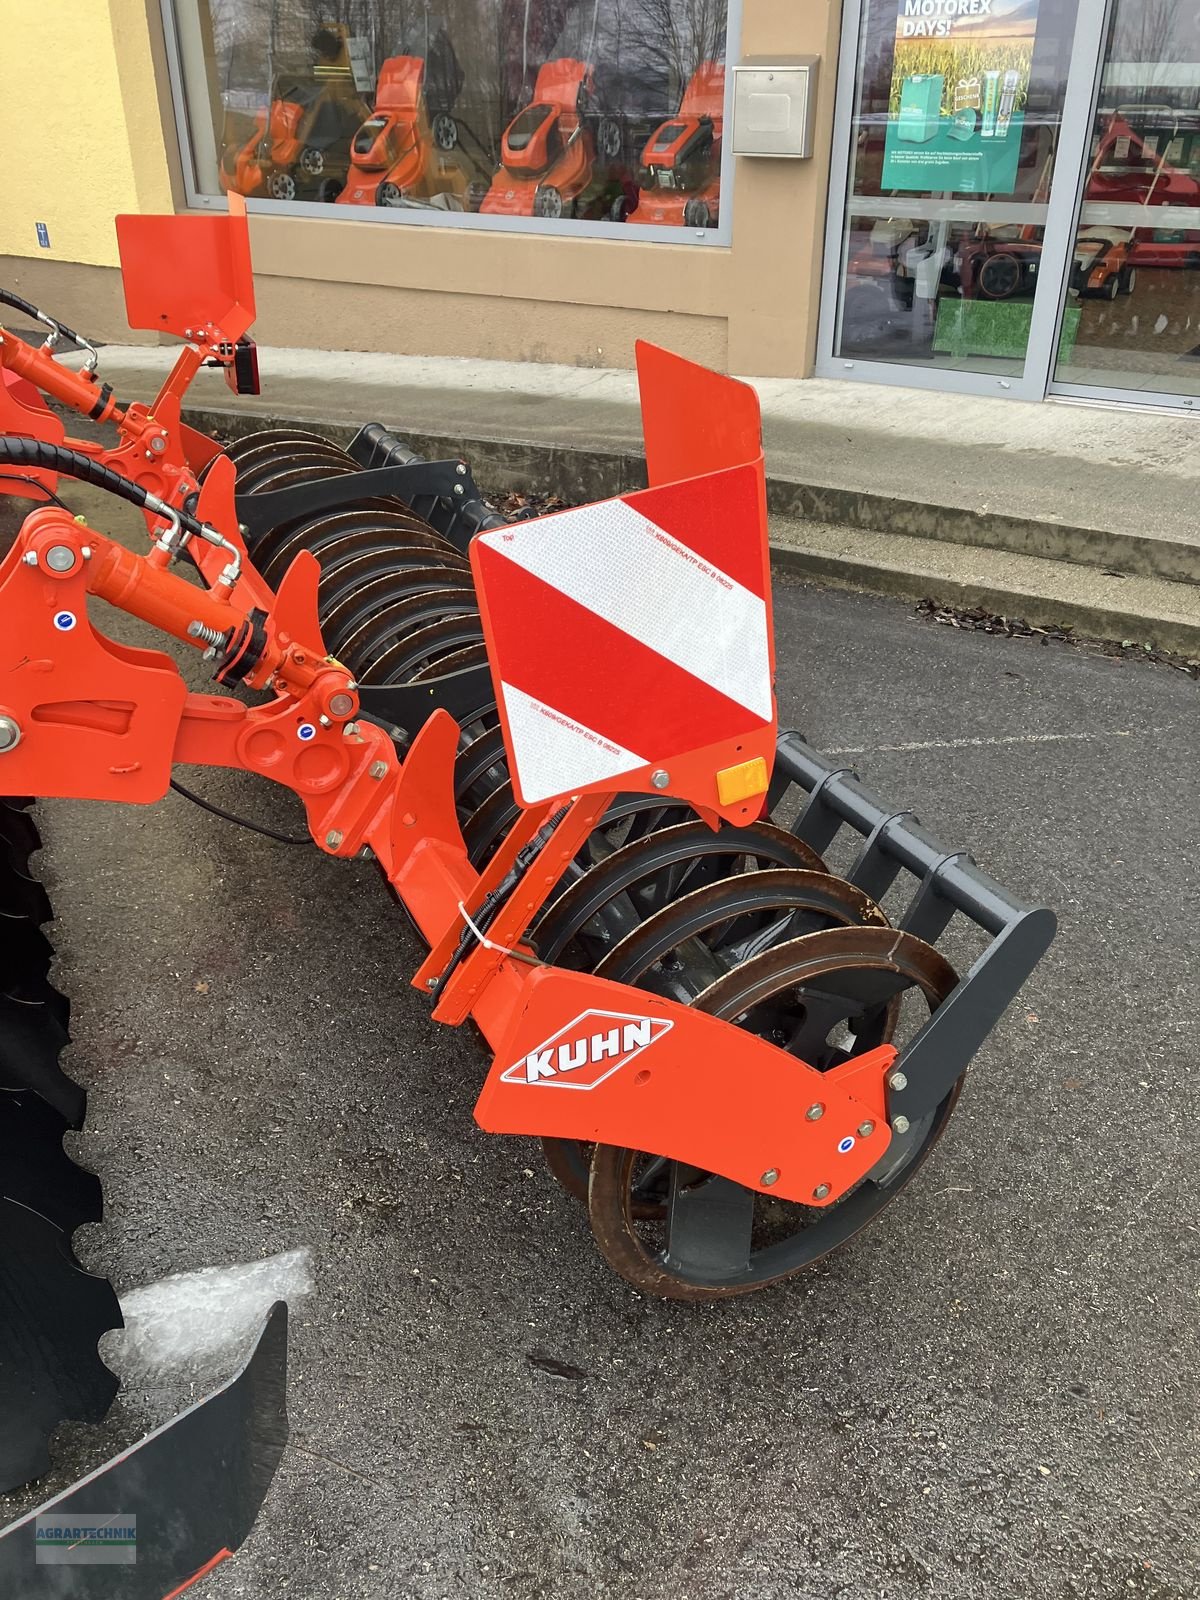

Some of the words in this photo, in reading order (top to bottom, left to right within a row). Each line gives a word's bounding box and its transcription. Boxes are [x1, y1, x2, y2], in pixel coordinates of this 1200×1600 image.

[904, 0, 991, 16] MOTOREX
[902, 19, 952, 37] DAYS!
[526, 1018, 651, 1083] KUHN
